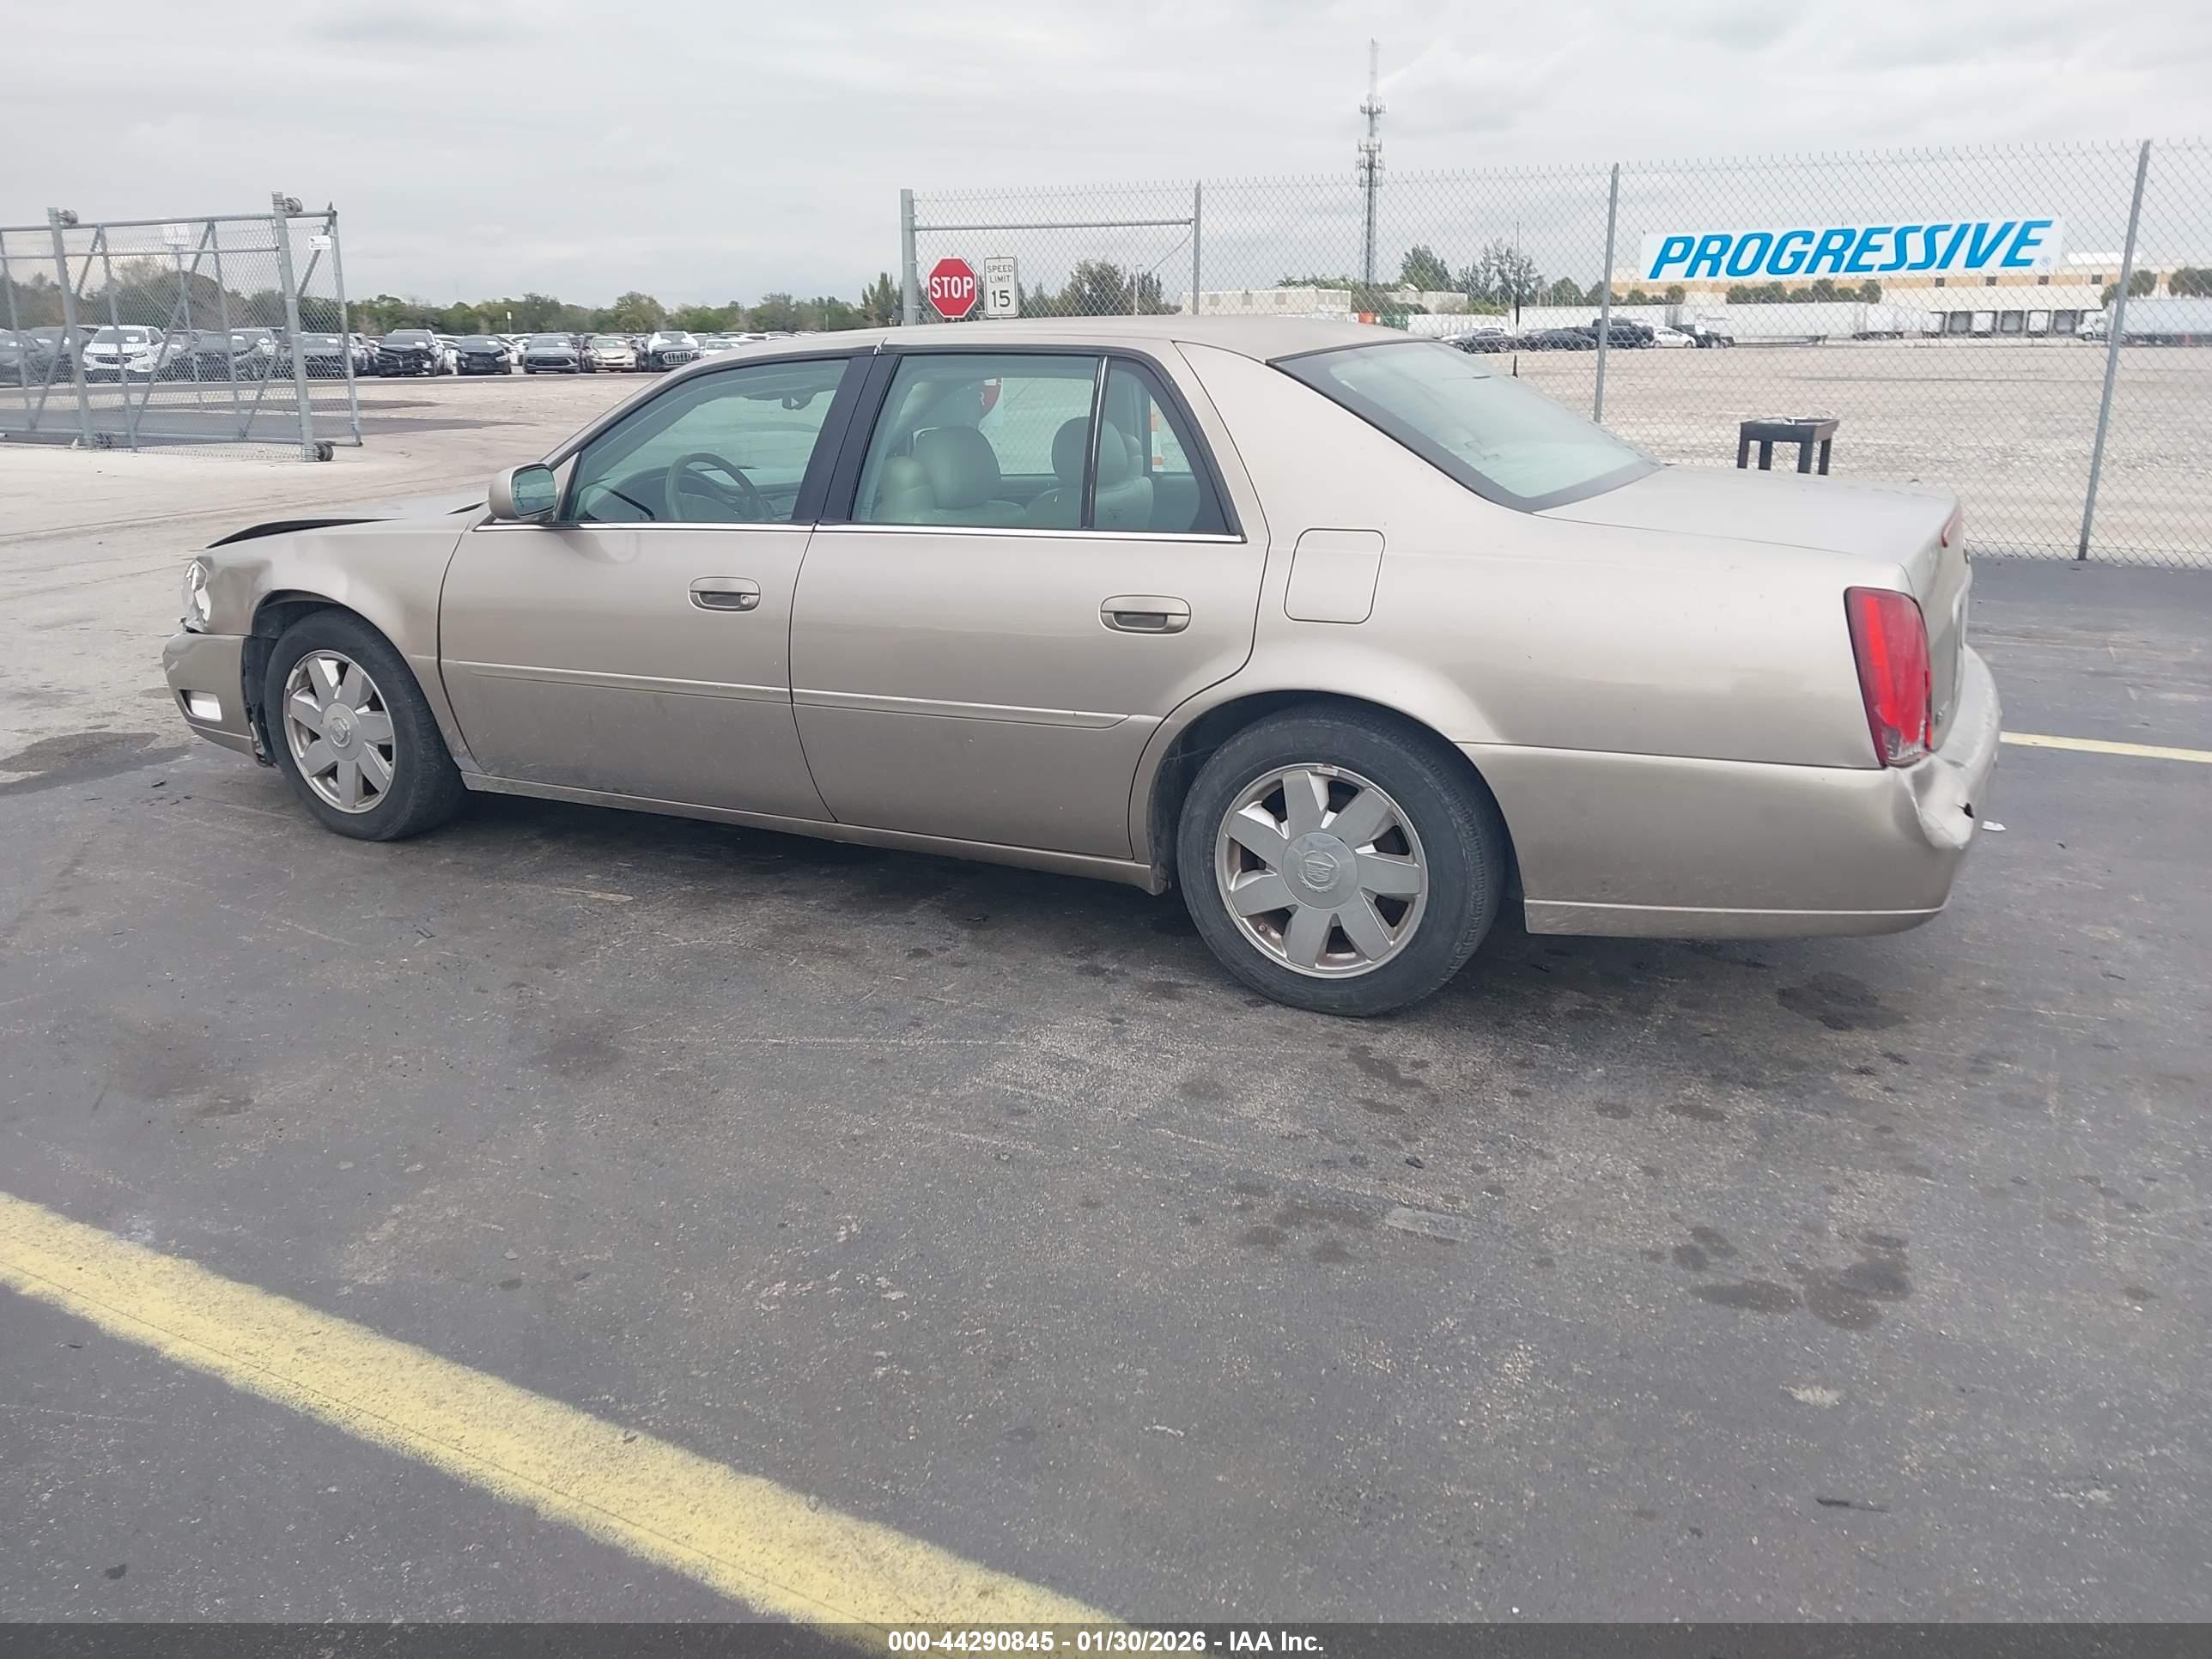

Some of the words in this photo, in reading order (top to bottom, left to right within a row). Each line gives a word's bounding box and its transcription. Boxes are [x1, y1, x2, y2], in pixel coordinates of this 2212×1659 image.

[1648, 219, 2053, 280] PROGRESSIVE
[987, 264, 1013, 273] SPEED
[932, 276, 974, 299] STOP
[989, 275, 1011, 283] LIMIT
[992, 289, 1011, 308] 15
